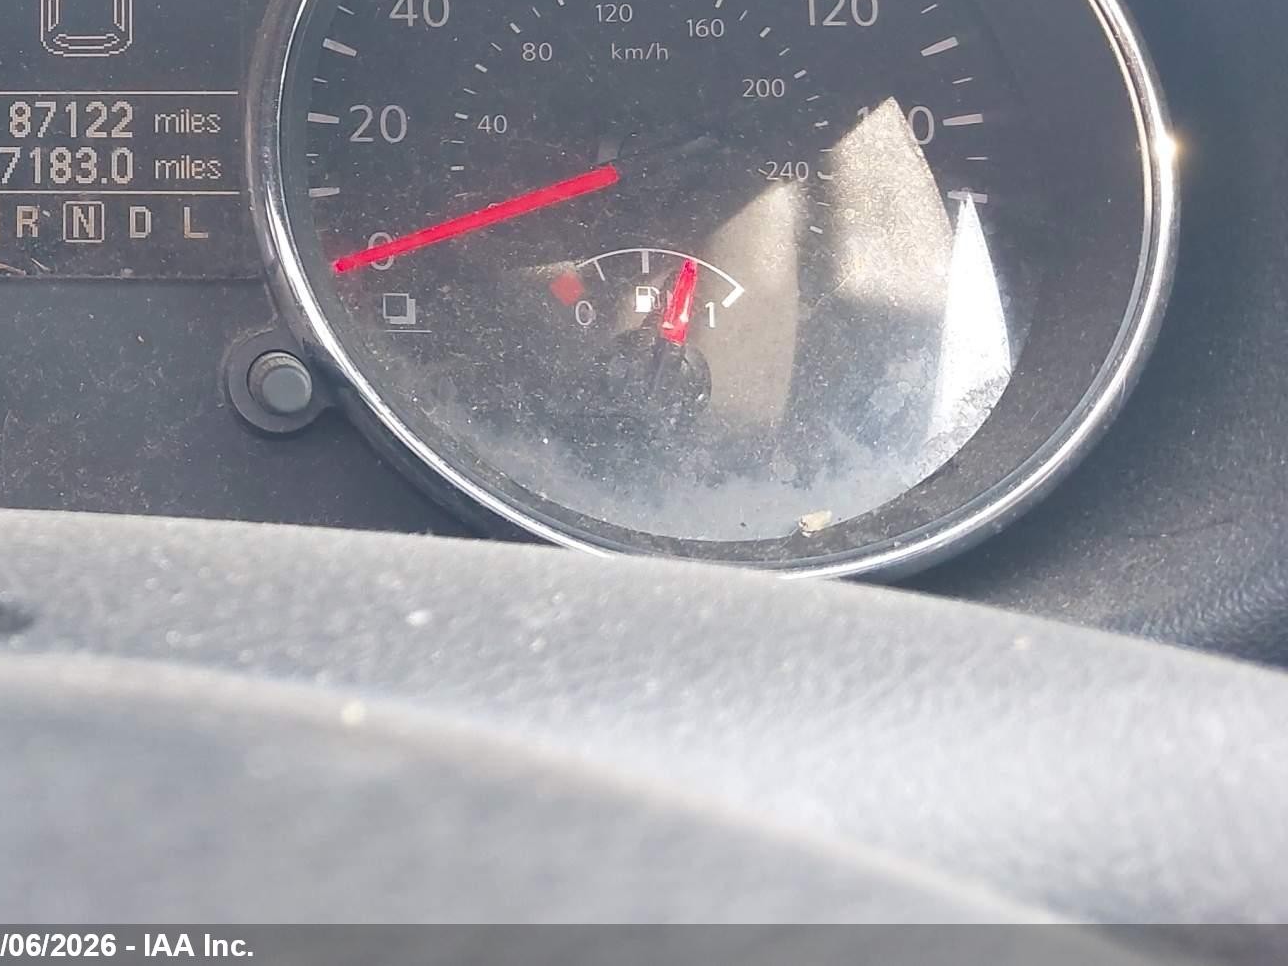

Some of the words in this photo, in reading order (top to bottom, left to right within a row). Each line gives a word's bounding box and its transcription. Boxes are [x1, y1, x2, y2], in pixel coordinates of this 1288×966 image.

[596, 3, 633, 22] 120
[686, 18, 724, 37] 160
[521, 43, 552, 61] 80
[611, 42, 669, 62] km/h
[742, 78, 784, 98] 200
[9, 102, 133, 137] 87122
[154, 110, 221, 132] miles
[349, 104, 408, 142] 20
[477, 115, 507, 132] 40
[0, 148, 133, 183] 7183.0
[154, 156, 221, 178] miles
[765, 161, 809, 180] 240
[17, 206, 38, 237] R
[130, 207, 151, 237] D
[184, 207, 208, 238] L
[575, 302, 596, 326] 0
[705, 302, 716, 327] 1
